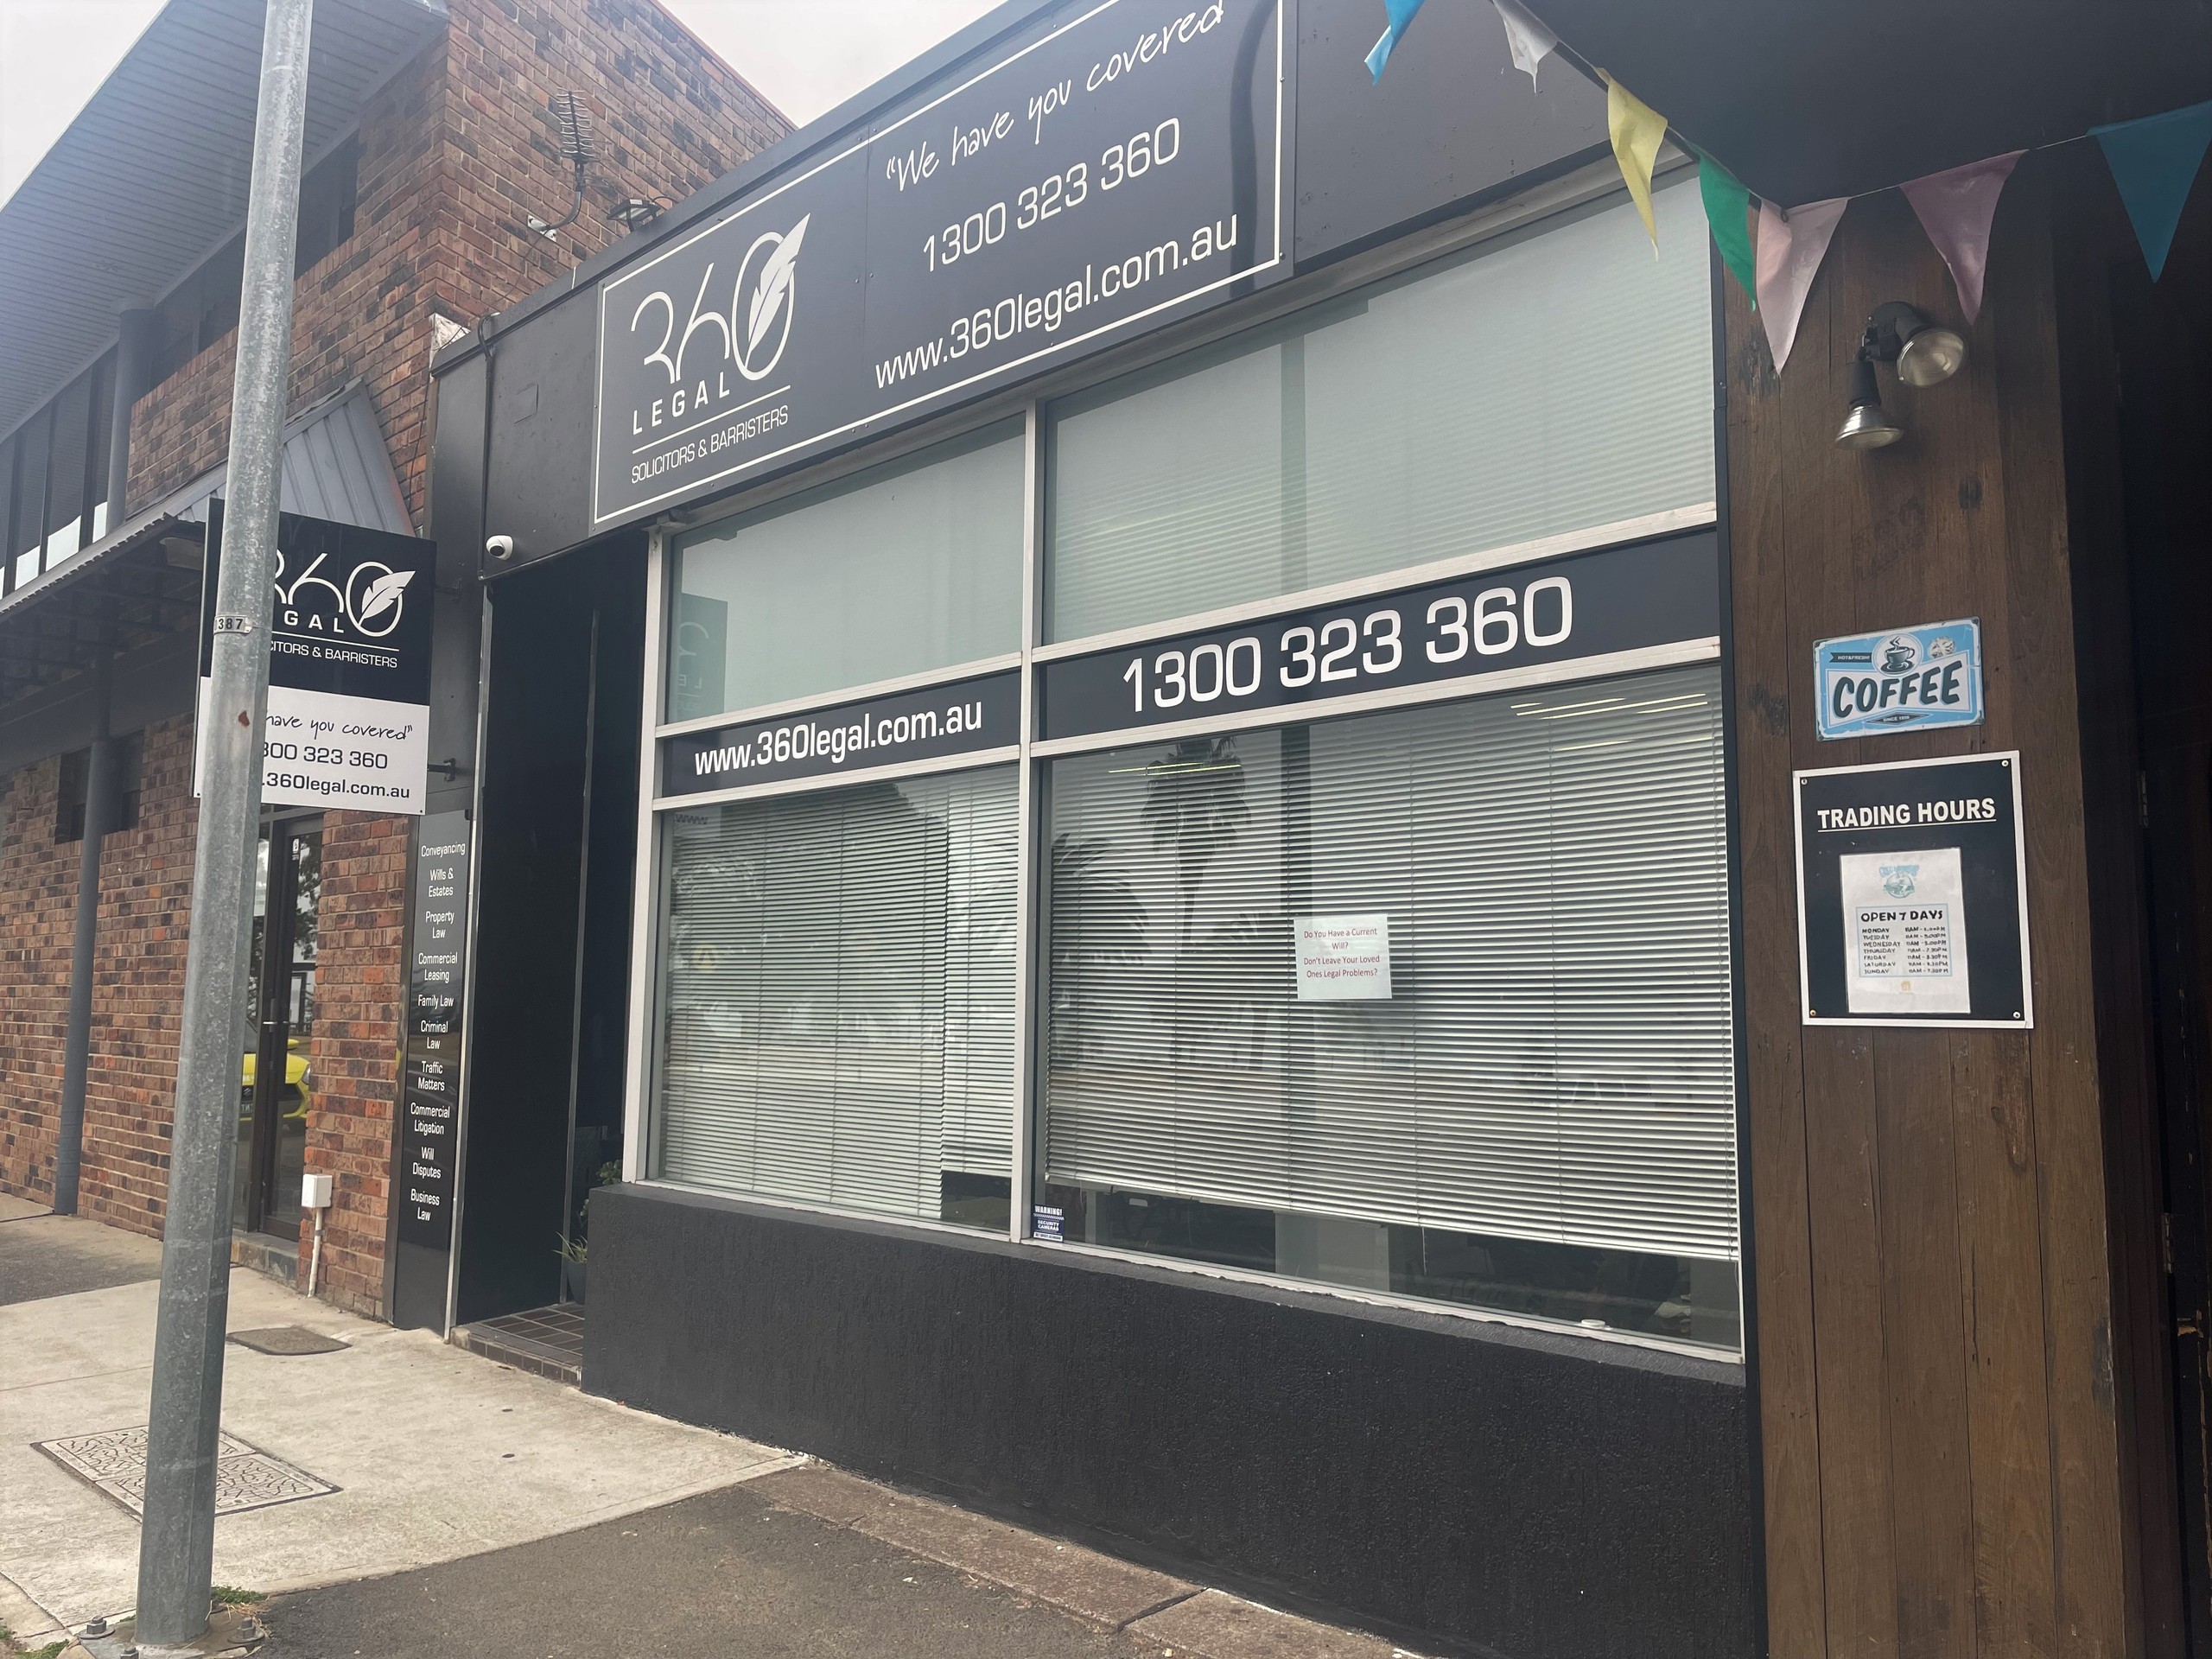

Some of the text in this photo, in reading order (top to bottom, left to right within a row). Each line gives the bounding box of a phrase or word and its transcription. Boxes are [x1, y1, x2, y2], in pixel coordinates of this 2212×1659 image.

[951, 110, 1014, 166] have
[1028, 79, 1071, 145] you
[923, 118, 1180, 272] 1300 323 360
[631, 231, 795, 385] 360
[874, 213, 1238, 390] www.360legal.com.au
[632, 372, 730, 435] LEGAL
[632, 404, 789, 484] SOLICITORS & BARRISTERS
[283, 610, 345, 633] GAL
[1122, 576, 1573, 713] 1300 323 360
[312, 647, 322, 658] &
[325, 648, 398, 669] BARRISTERS
[1832, 660, 1962, 718] COFFEE
[310, 720, 334, 740] you
[694, 700, 982, 776] www.360legal.com.au
[303, 746, 343, 765] 323
[349, 751, 388, 769] 360
[262, 772, 410, 798] .360legal.com.au
[1817, 798, 1996, 830] TRADING HOURS
[421, 842, 466, 858] Conveyancing
[429, 868, 454, 881] Wills &
[428, 886, 454, 898] Estates
[425, 911, 455, 925] Property
[1860, 910, 1943, 923] OPEN 7 DAYS
[432, 927, 446, 939] Law
[1313, 930, 1326, 938] You
[1327, 929, 1344, 938] Have
[1351, 927, 1377, 937] Current
[1332, 941, 1349, 950] Will?
[418, 951, 458, 965] Commercial
[1304, 954, 1380, 966] Don't Leave Your Loved
[424, 969, 450, 984] Leasing
[1306, 968, 1378, 979] Ones Legal Problems?
[417, 995, 454, 1010] Family Law
[420, 1020, 448, 1033] Criminal
[426, 1037, 441, 1050] Law
[421, 1060, 443, 1074] Traffic
[417, 1077, 445, 1091] Matters
[410, 1103, 450, 1119] Commercial
[414, 1120, 445, 1136] Litigation
[421, 1147, 435, 1160] Will
[412, 1162, 442, 1180] Disputes
[410, 1188, 440, 1206] Business
[417, 1207, 431, 1222] Law
[1035, 1205, 1062, 1216] WARNING!
